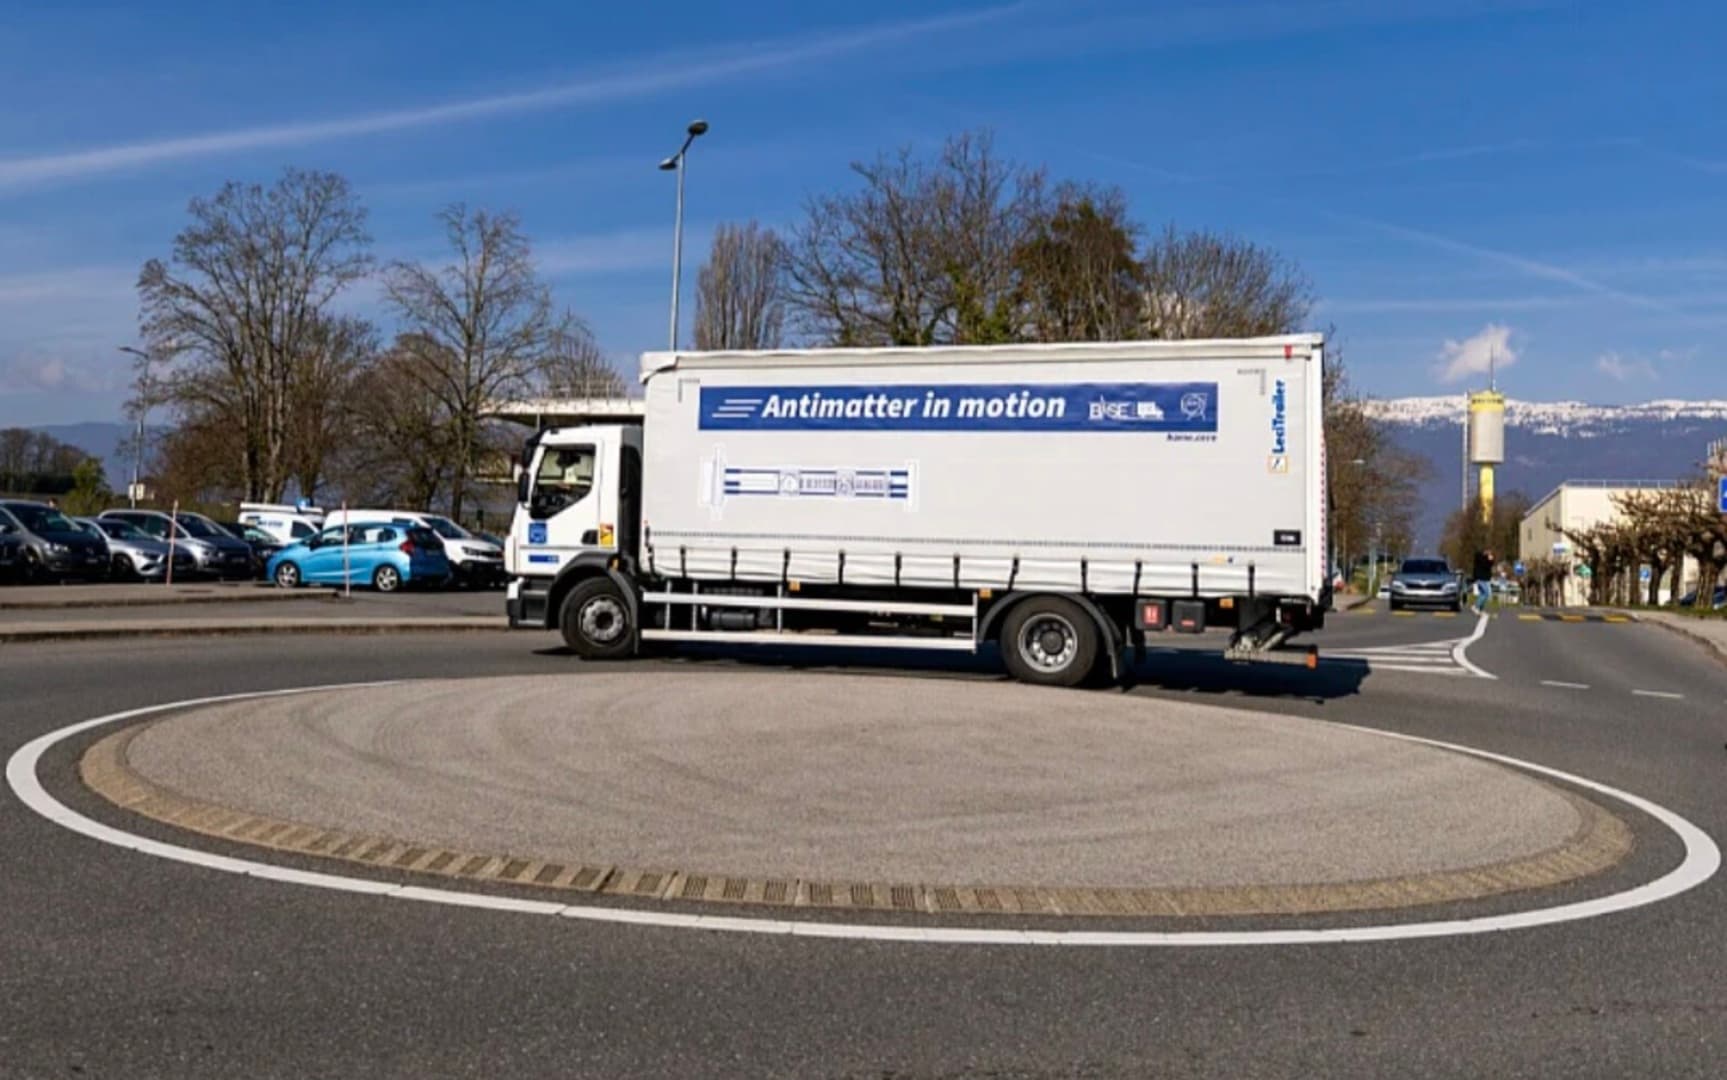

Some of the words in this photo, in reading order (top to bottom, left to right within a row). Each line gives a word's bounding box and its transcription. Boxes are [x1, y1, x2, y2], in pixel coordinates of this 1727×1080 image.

[761, 392, 918, 420] Antimatter
[922, 390, 951, 418] in
[956, 390, 1067, 418] motion
